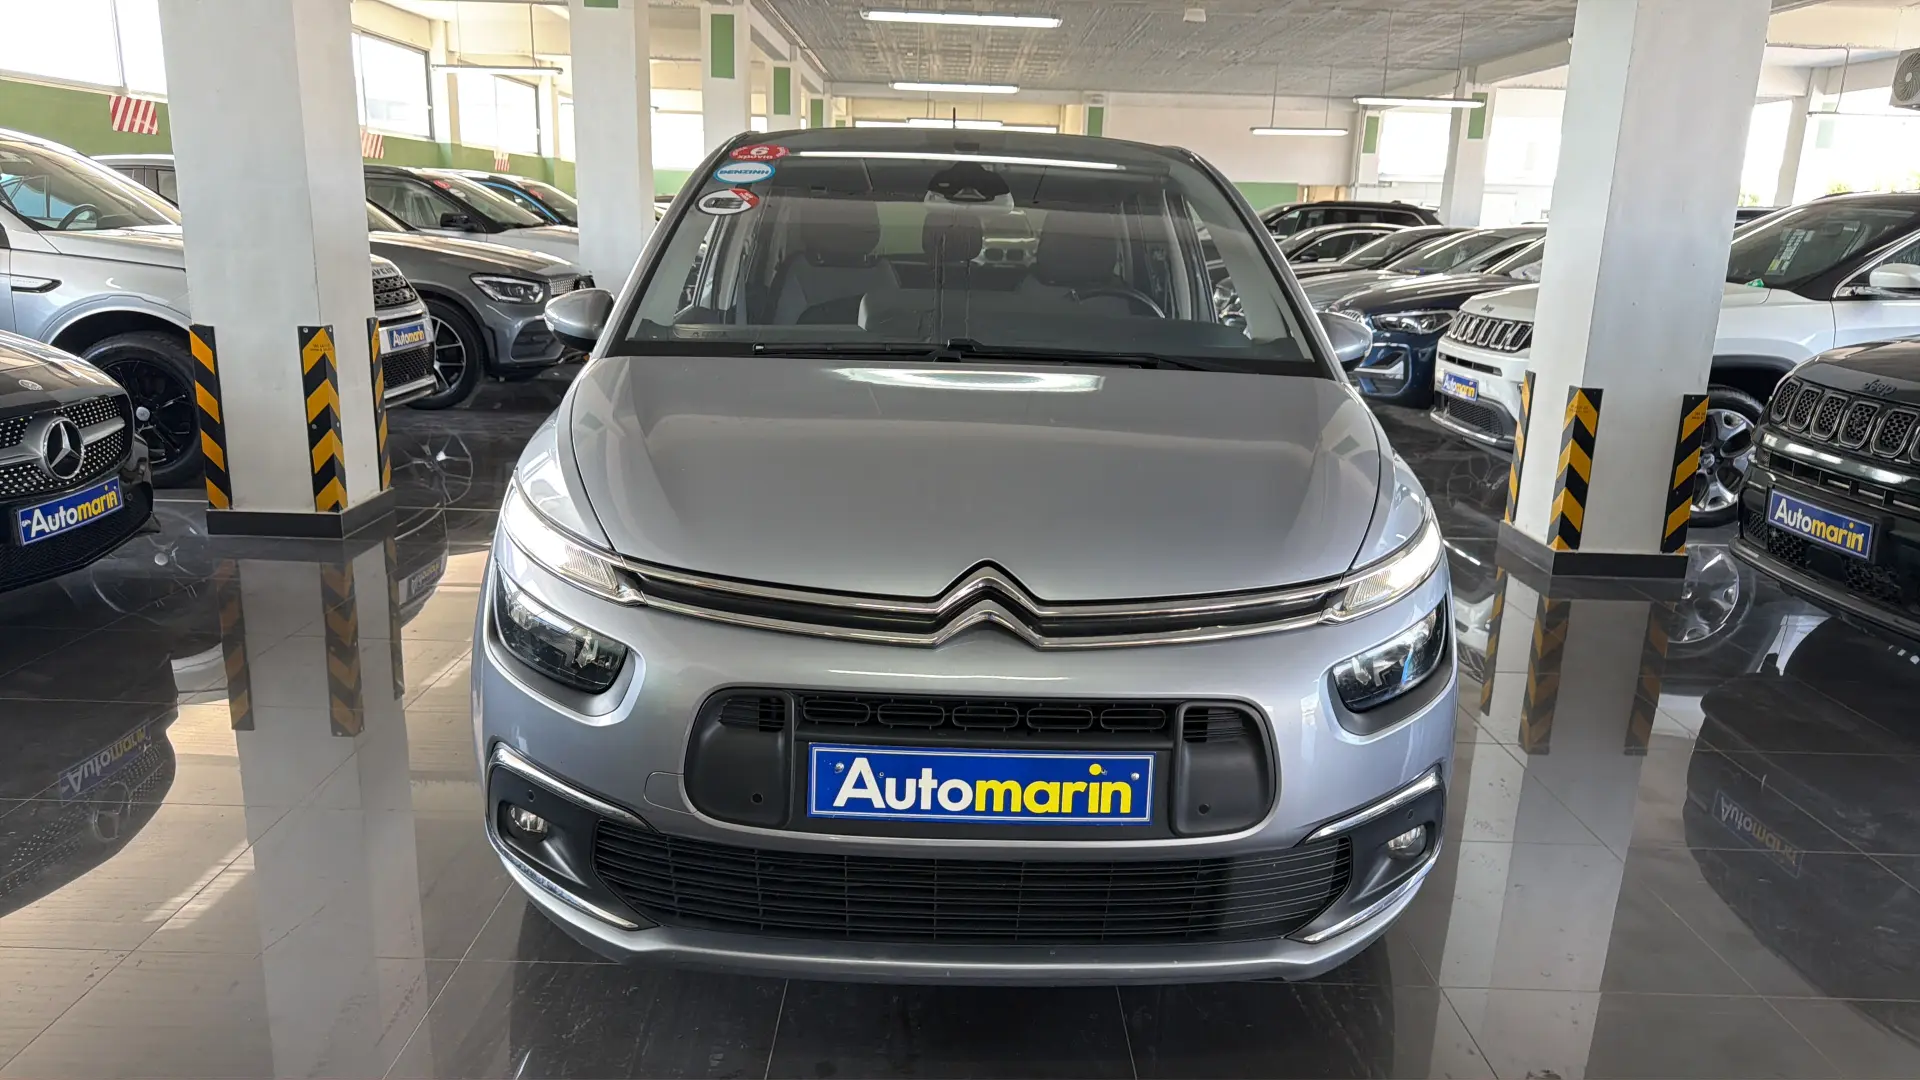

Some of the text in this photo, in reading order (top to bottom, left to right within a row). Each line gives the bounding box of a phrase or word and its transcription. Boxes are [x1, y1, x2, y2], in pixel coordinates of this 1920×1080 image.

[750, 146, 769, 156] 6
[30, 485, 119, 538] Automarin
[1774, 498, 1865, 552] Automarin
[832, 757, 1132, 814] Automarin
